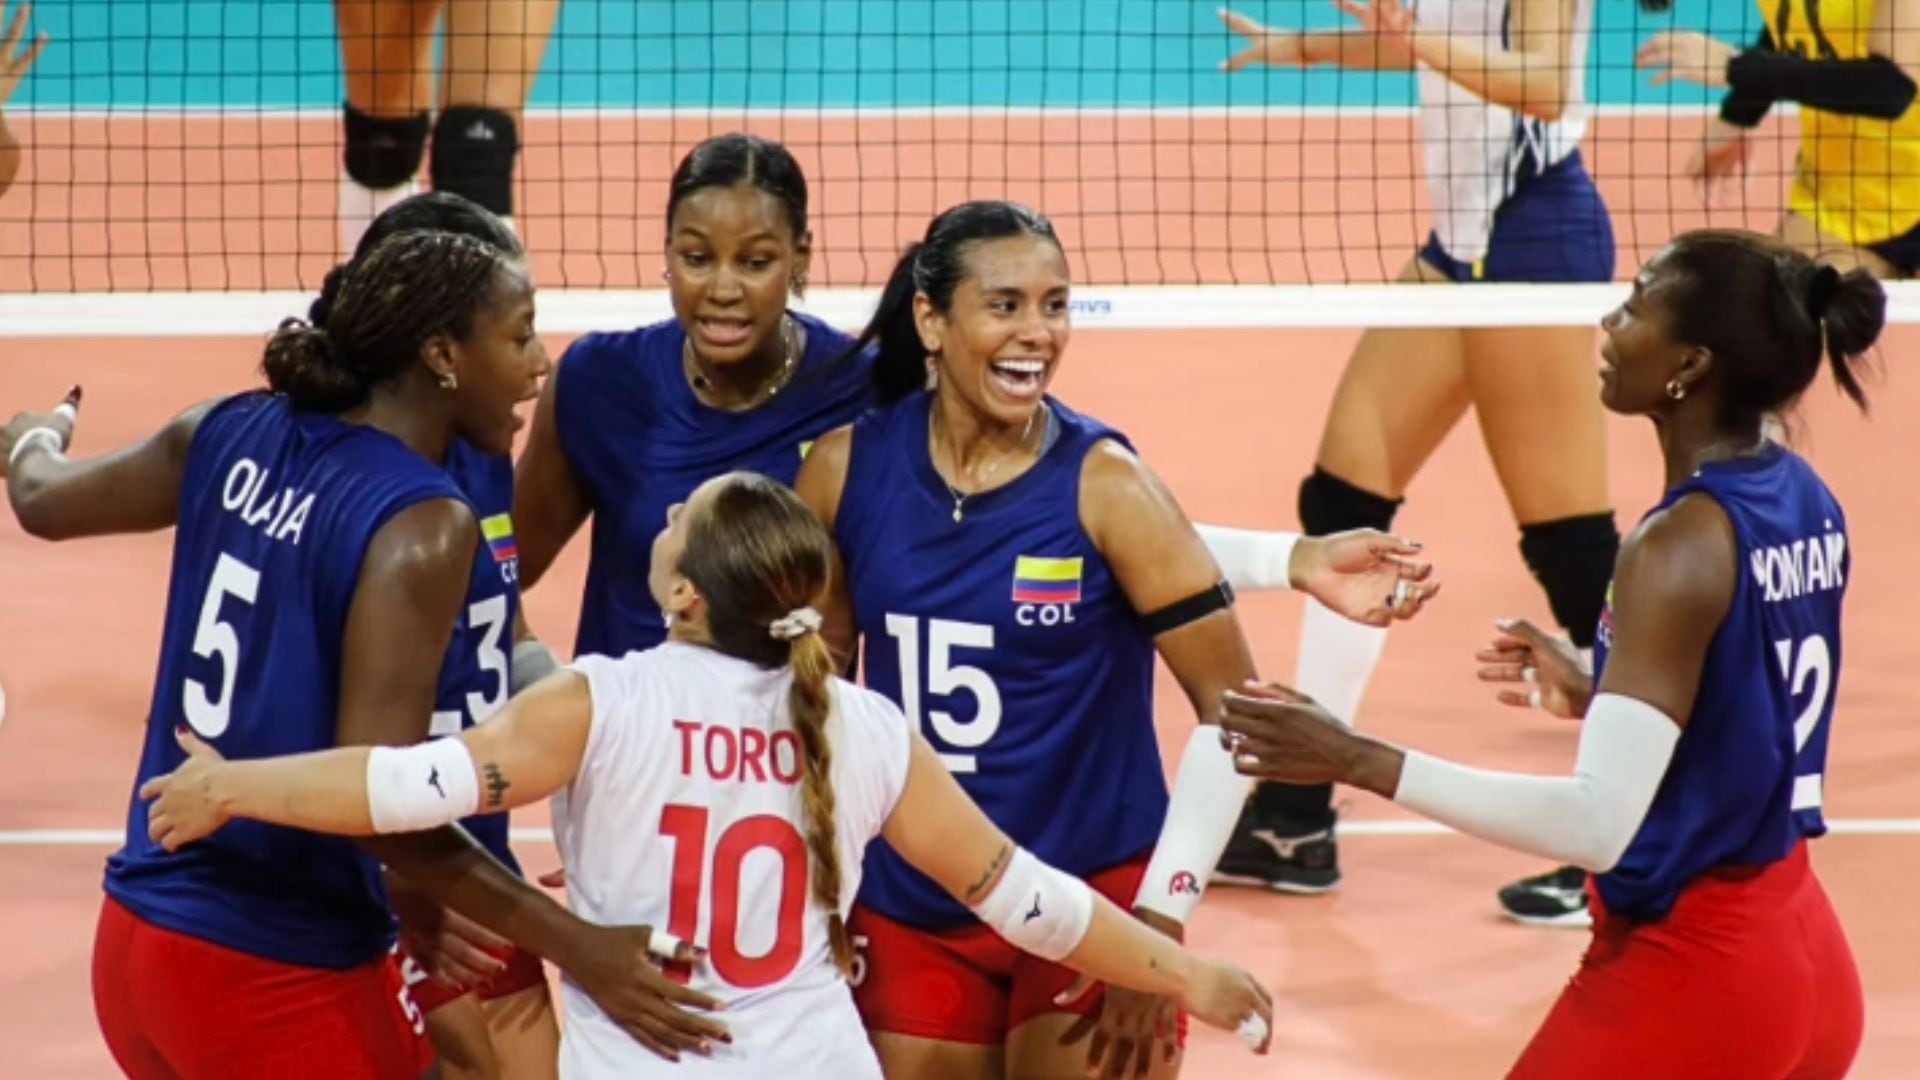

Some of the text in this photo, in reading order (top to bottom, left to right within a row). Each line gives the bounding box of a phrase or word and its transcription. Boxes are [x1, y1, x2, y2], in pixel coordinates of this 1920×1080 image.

[183, 551, 261, 738] 5
[885, 612, 1003, 748] 15
[1014, 603, 1076, 627] COL
[672, 718, 805, 786] TORO
[1774, 633, 1831, 811] 2
[658, 803, 809, 990] 10
